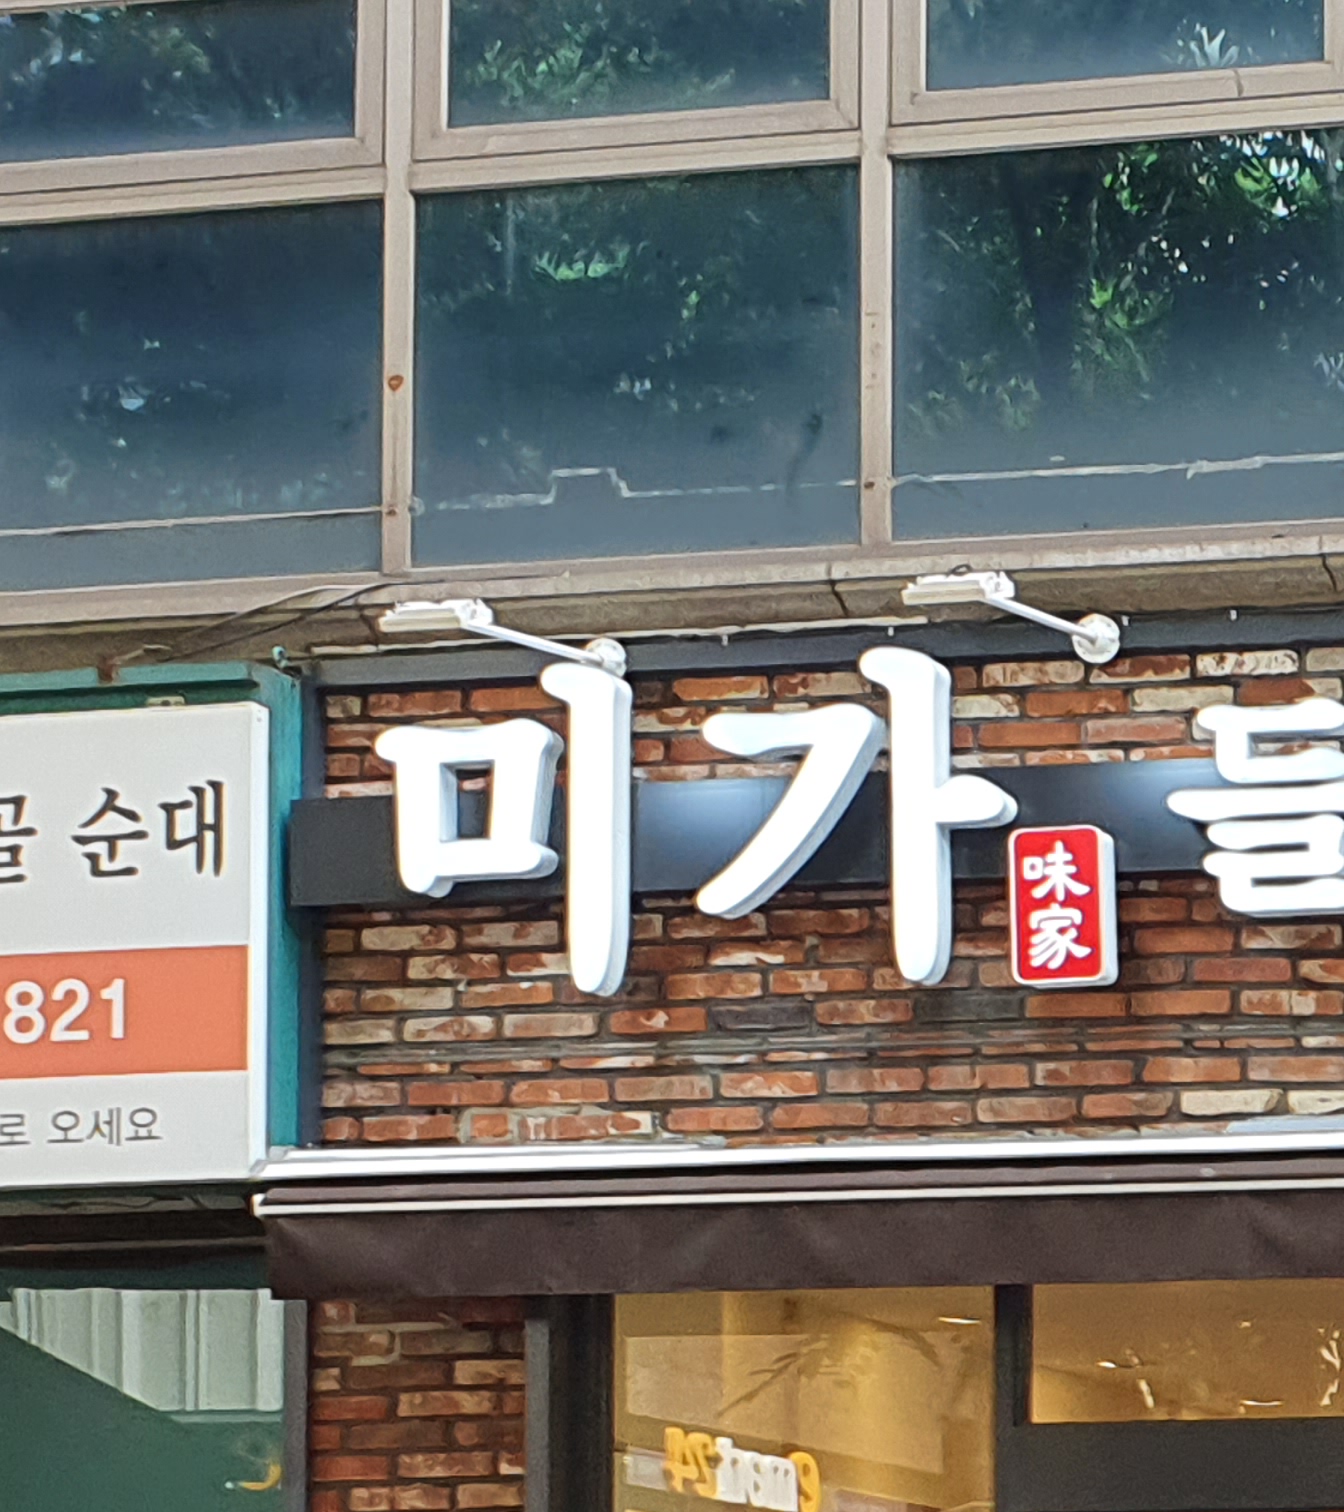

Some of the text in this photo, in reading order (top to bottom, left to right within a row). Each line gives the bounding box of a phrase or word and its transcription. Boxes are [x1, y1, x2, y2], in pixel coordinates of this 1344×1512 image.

[71, 780, 227, 878] 순대
[375, 647, 1018, 997] 미가
[1022, 840, 1092, 971] 味家
[3, 977, 127, 1045] 821
[47, 1106, 163, 1147] 오세요
